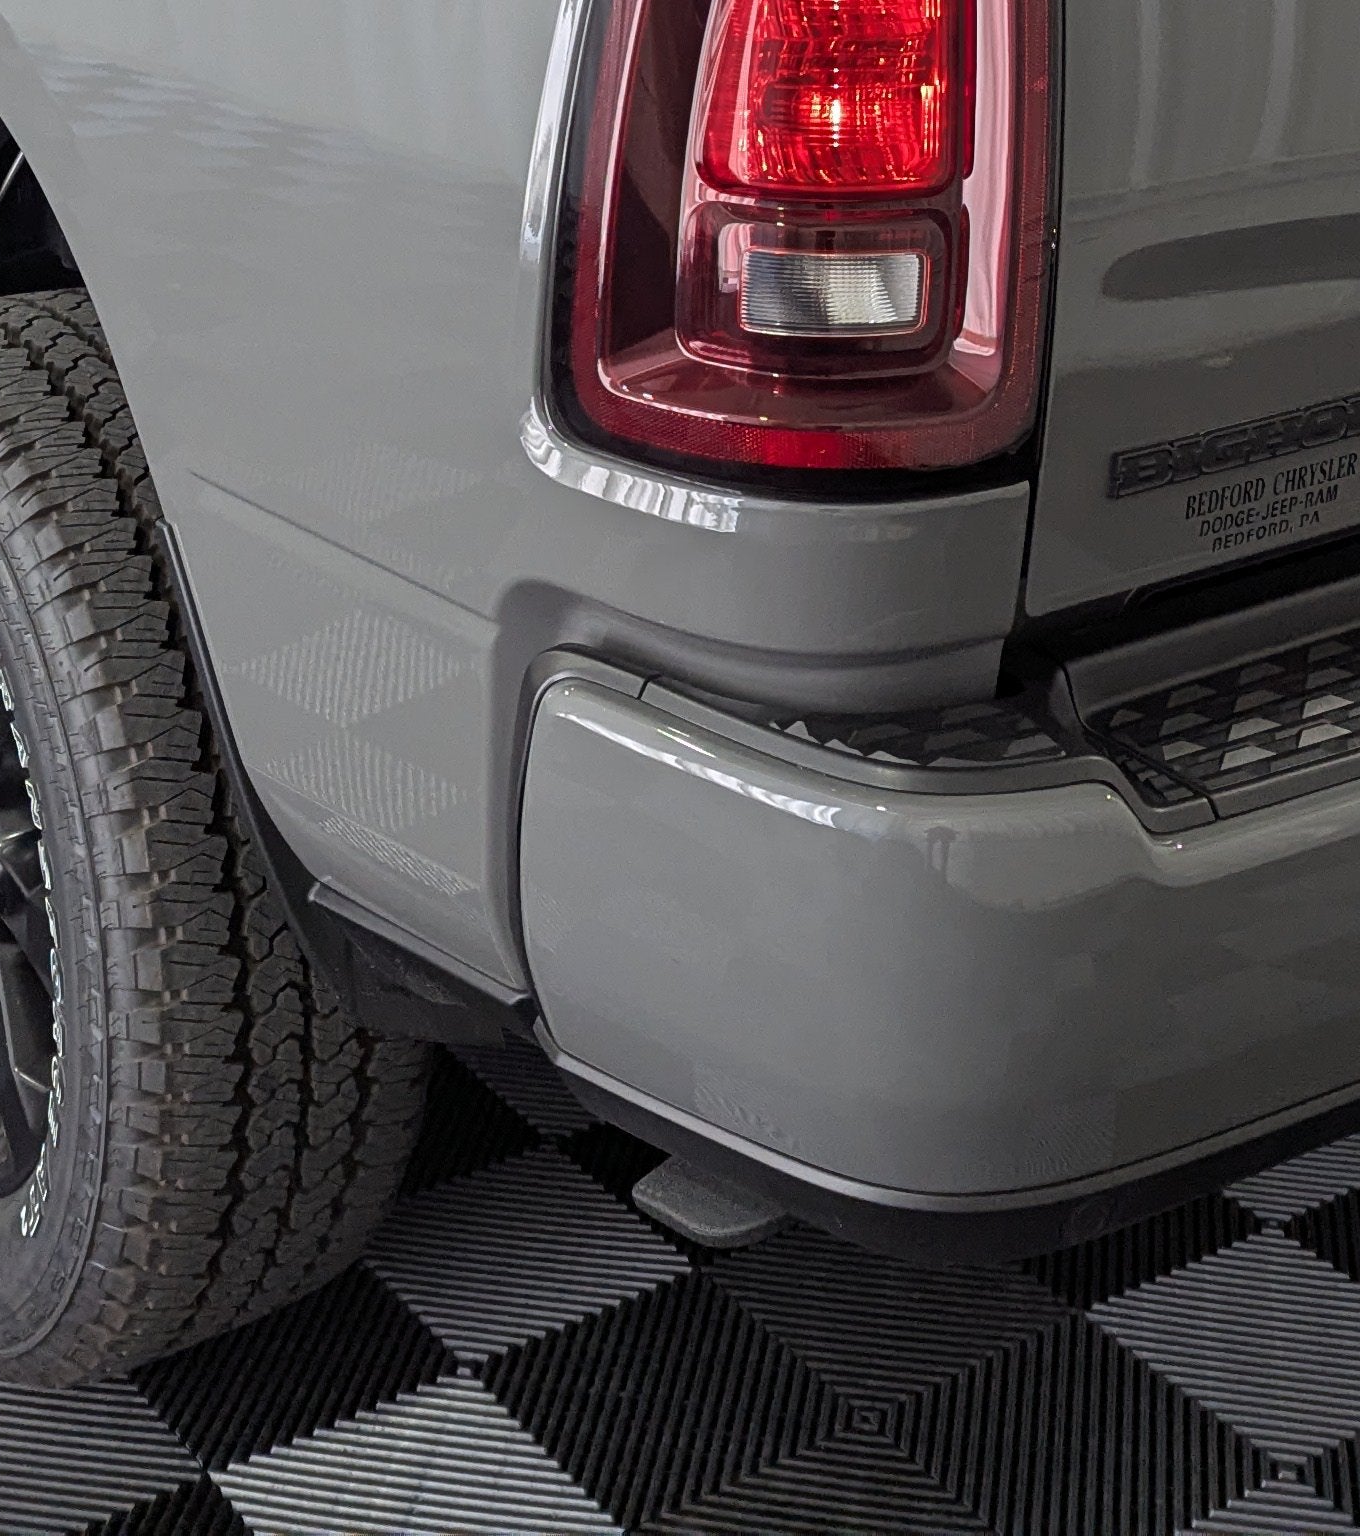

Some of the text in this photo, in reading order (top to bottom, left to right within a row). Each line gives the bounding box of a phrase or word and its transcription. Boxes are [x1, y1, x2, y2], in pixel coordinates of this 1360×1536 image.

[1185, 452, 1358, 520] BEDFORD CHRYSLER
[1299, 509, 1321, 528] PA
